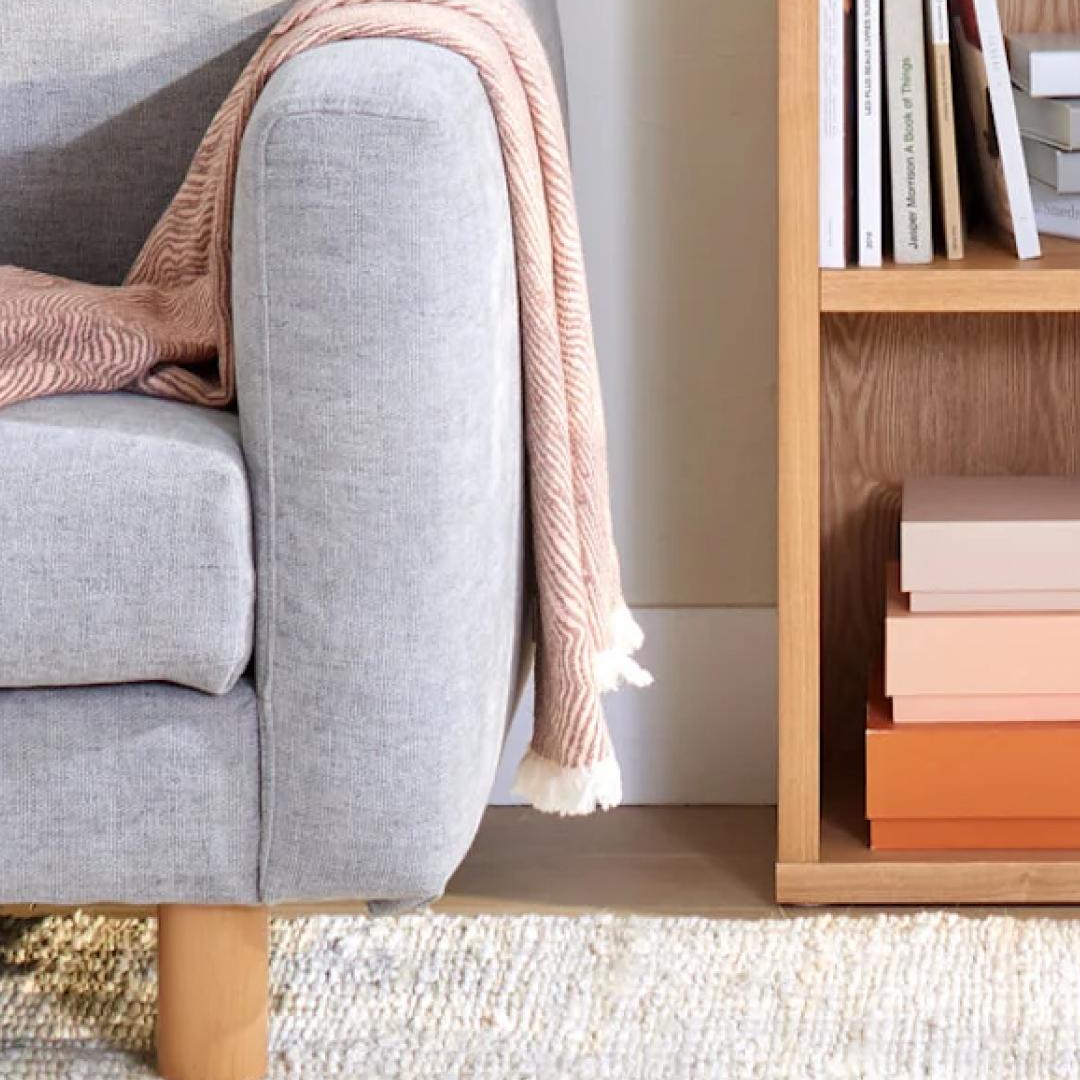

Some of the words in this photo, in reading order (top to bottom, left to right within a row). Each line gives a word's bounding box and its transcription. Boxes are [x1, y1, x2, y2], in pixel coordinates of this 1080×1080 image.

[863, 77, 872, 99] PLUS
[902, 56, 914, 95] Things
[902, 98, 913, 109] of
[903, 111, 914, 142] Book
[903, 145, 915, 154] A
[906, 156, 916, 208] Morrison
[907, 211, 918, 250] Jasper
